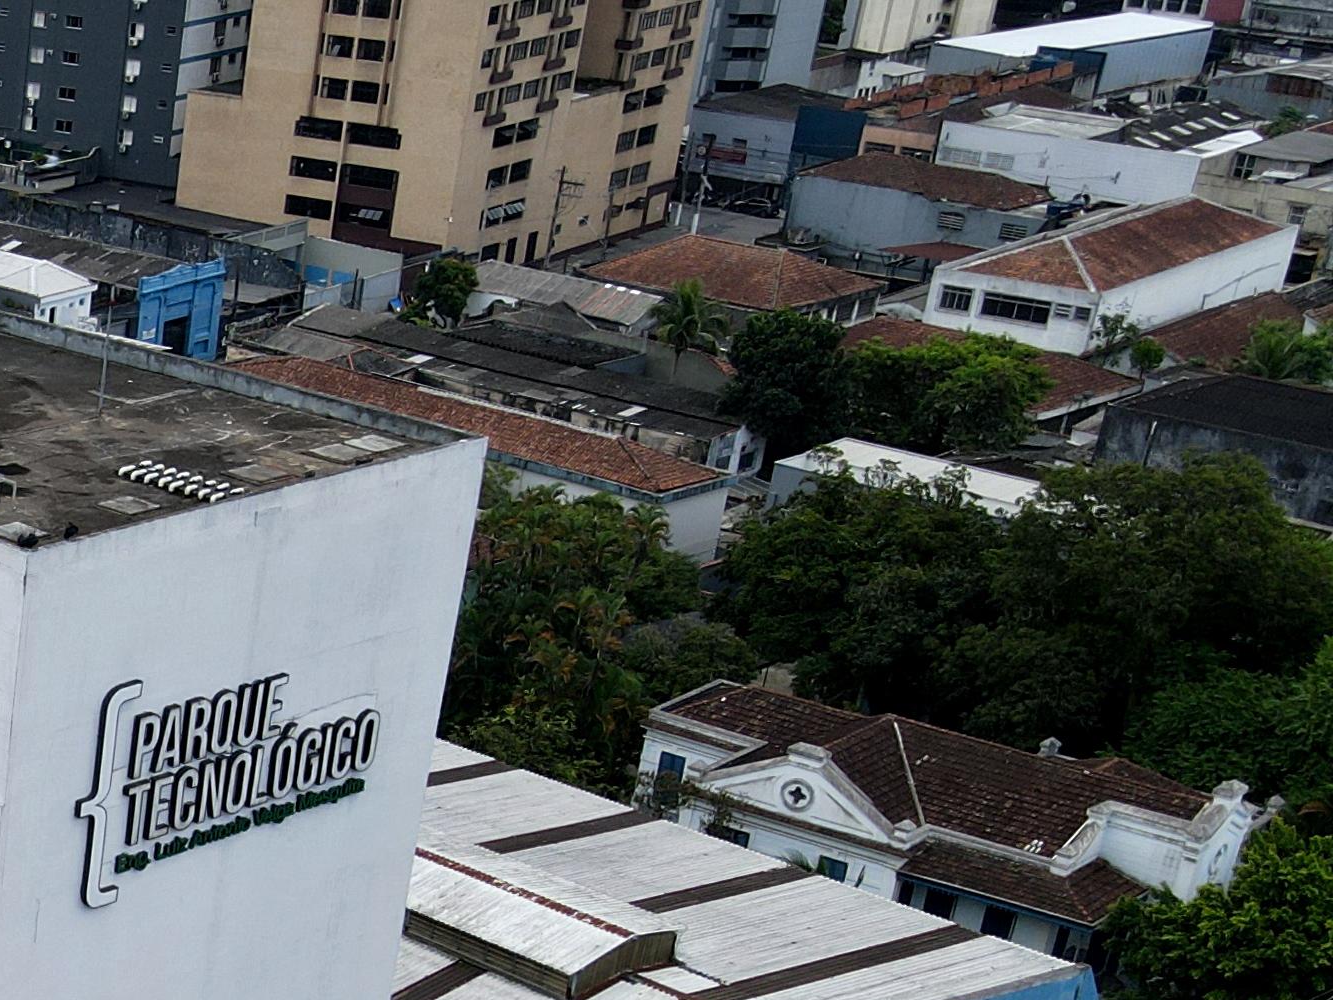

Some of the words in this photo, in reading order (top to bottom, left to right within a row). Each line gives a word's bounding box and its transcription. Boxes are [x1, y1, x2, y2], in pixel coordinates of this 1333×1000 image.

[122, 709, 381, 846] TECNOLÓGICO
[127, 672, 290, 780] PARQUE
[188, 815, 251, 850] Antonio
